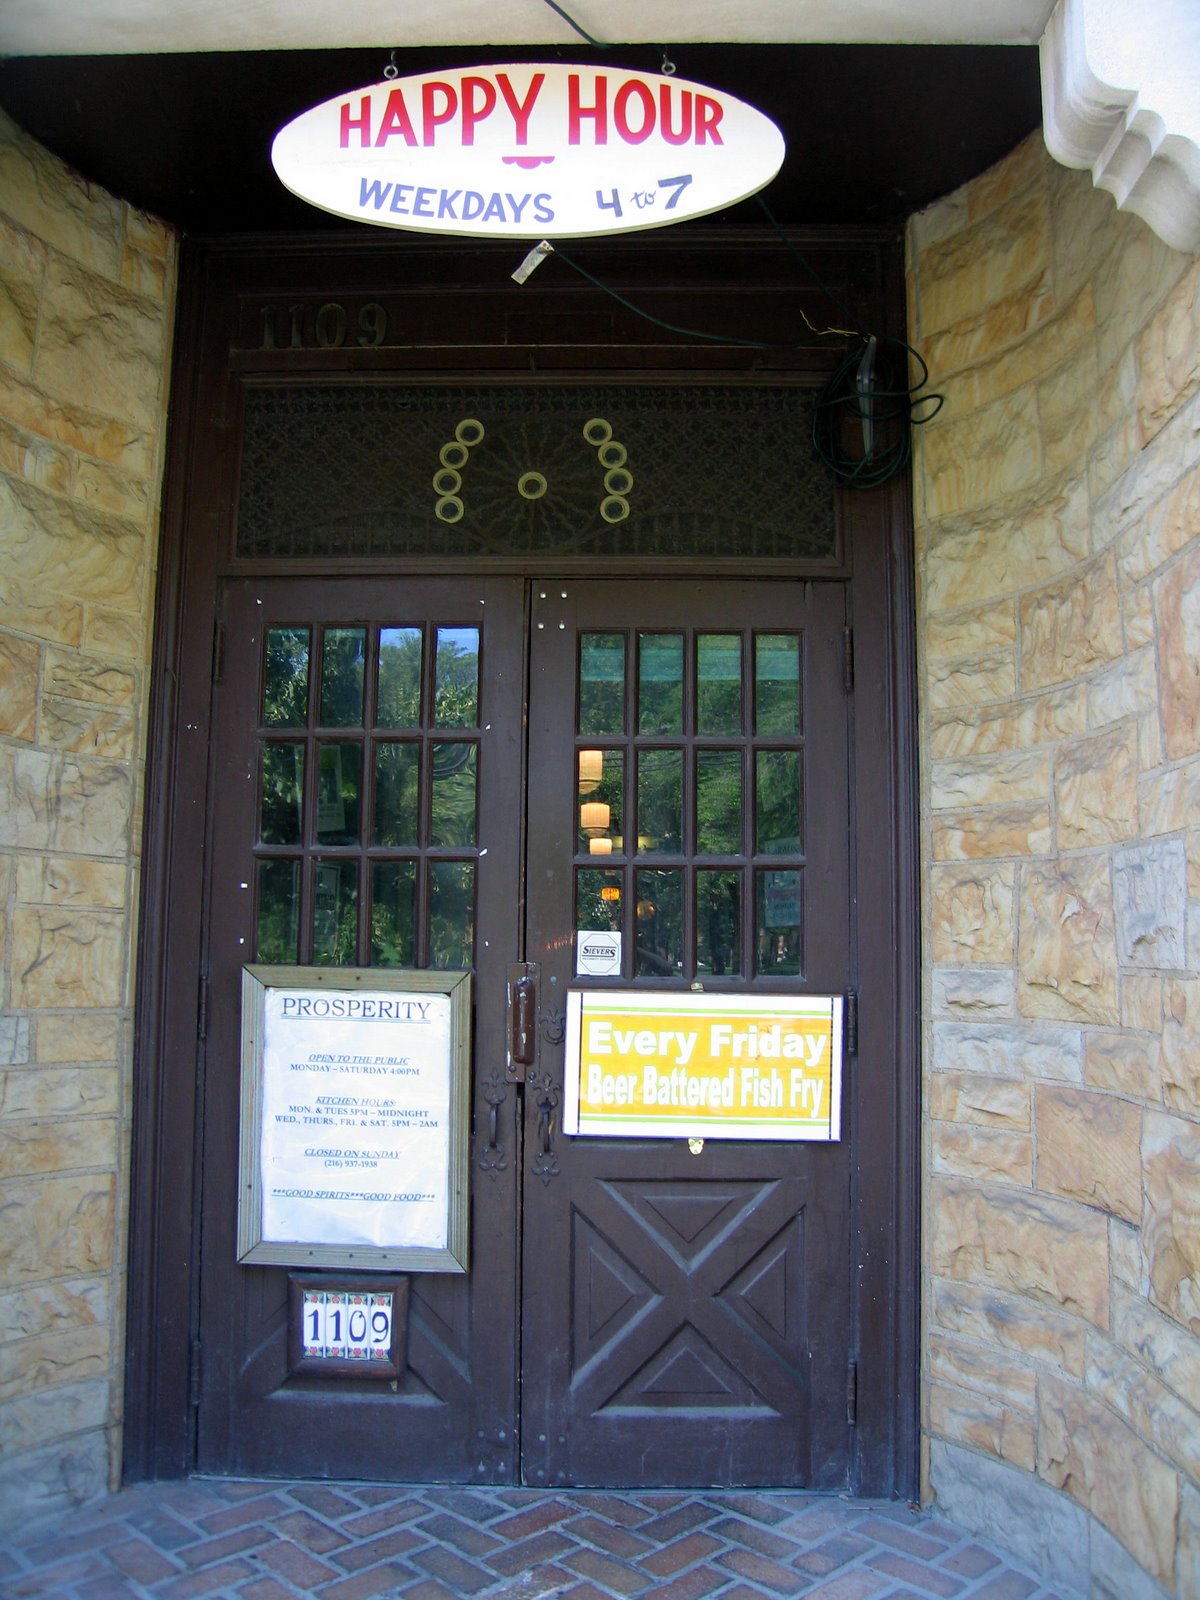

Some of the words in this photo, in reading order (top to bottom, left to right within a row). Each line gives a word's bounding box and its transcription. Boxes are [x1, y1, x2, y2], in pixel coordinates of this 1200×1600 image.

[340, 73, 545, 148] HAPPY
[568, 74, 724, 146] HOUR
[359, 177, 555, 223] WEEKDAYS
[596, 188, 623, 217] 4
[630, 190, 656, 209] to
[657, 174, 693, 210] 7
[259, 302, 387, 348] 1109
[582, 945, 616, 958] SIEVERS
[283, 998, 431, 1019] PROSPERITY
[588, 1021, 698, 1065] Every
[710, 1024, 827, 1067] Friday
[308, 1053, 334, 1063] OPEN
[338, 1055, 351, 1063] TO
[352, 1055, 372, 1064] THE
[374, 1056, 410, 1065] PUBLIC
[290, 1064, 331, 1072] MONDAY
[339, 1066, 389, 1074] SATURDAY
[390, 1067, 420, 1076] 4:00PM
[587, 1064, 638, 1105] Beer
[643, 1066, 734, 1108] Battered
[740, 1067, 783, 1108] Fish
[790, 1068, 824, 1119] Fry
[315, 1096, 359, 1105] KITCHEN
[289, 1106, 313, 1114] MON.
[315, 1106, 322, 1114] &
[324, 1107, 348, 1115] TUES
[349, 1108, 368, 1116] 5PM
[377, 1109, 430, 1118] MIDNIGHT
[275, 1115, 301, 1124] WED.,
[303, 1116, 338, 1126] THURS.,
[340, 1118, 358, 1126] FRI.
[369, 1119, 390, 1127] SAT.
[391, 1119, 410, 1128] 5PM
[419, 1120, 439, 1128] 2AM
[304, 1148, 343, 1157] CLOSED
[344, 1150, 361, 1158] ON
[362, 1150, 400, 1159] SUNDAY
[324, 1159, 343, 1168] (216)
[344, 1160, 378, 1168] 937-1938
[308, 1309, 389, 1343] 1109
